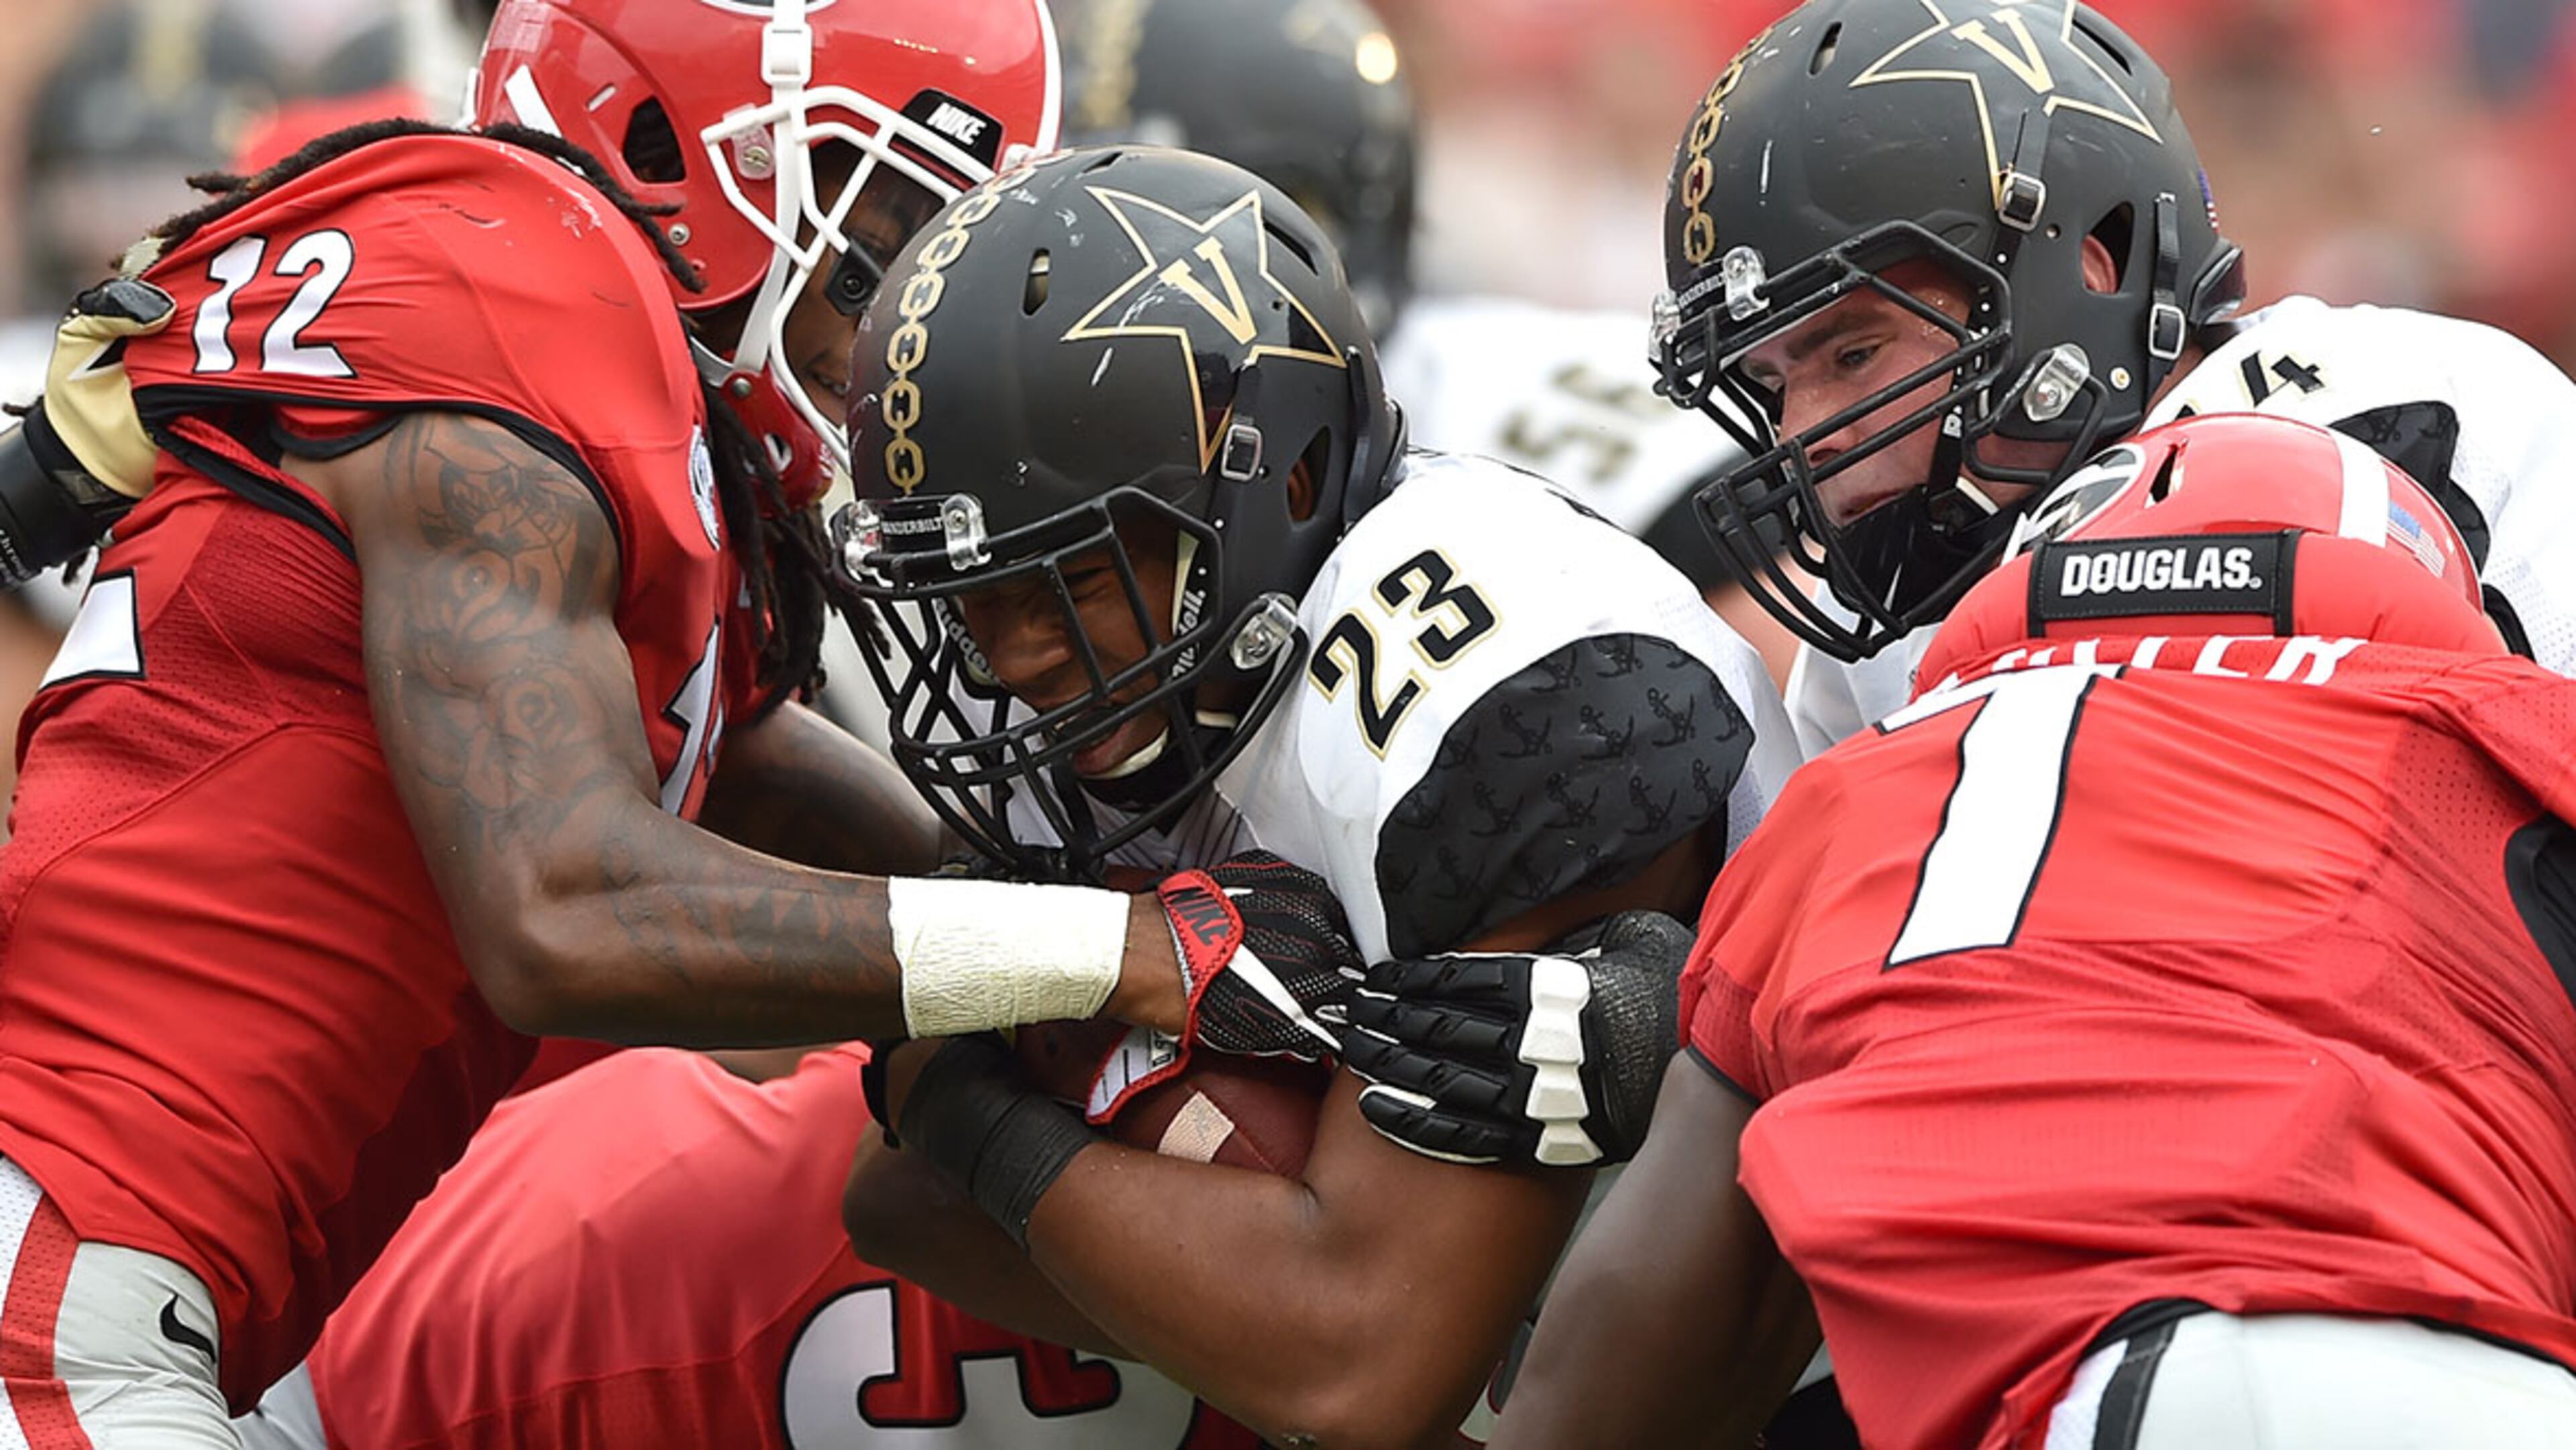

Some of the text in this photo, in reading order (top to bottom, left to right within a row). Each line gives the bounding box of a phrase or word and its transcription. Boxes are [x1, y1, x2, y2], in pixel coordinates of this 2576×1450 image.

[1950, 8, 2055, 94] V
[926, 102, 987, 145] NIKE
[192, 228, 358, 378] 12
[1158, 236, 1258, 345] V
[1309, 549, 1497, 759] 23
[1874, 661, 2129, 974] 7
[1163, 887, 1230, 946] NIKE
